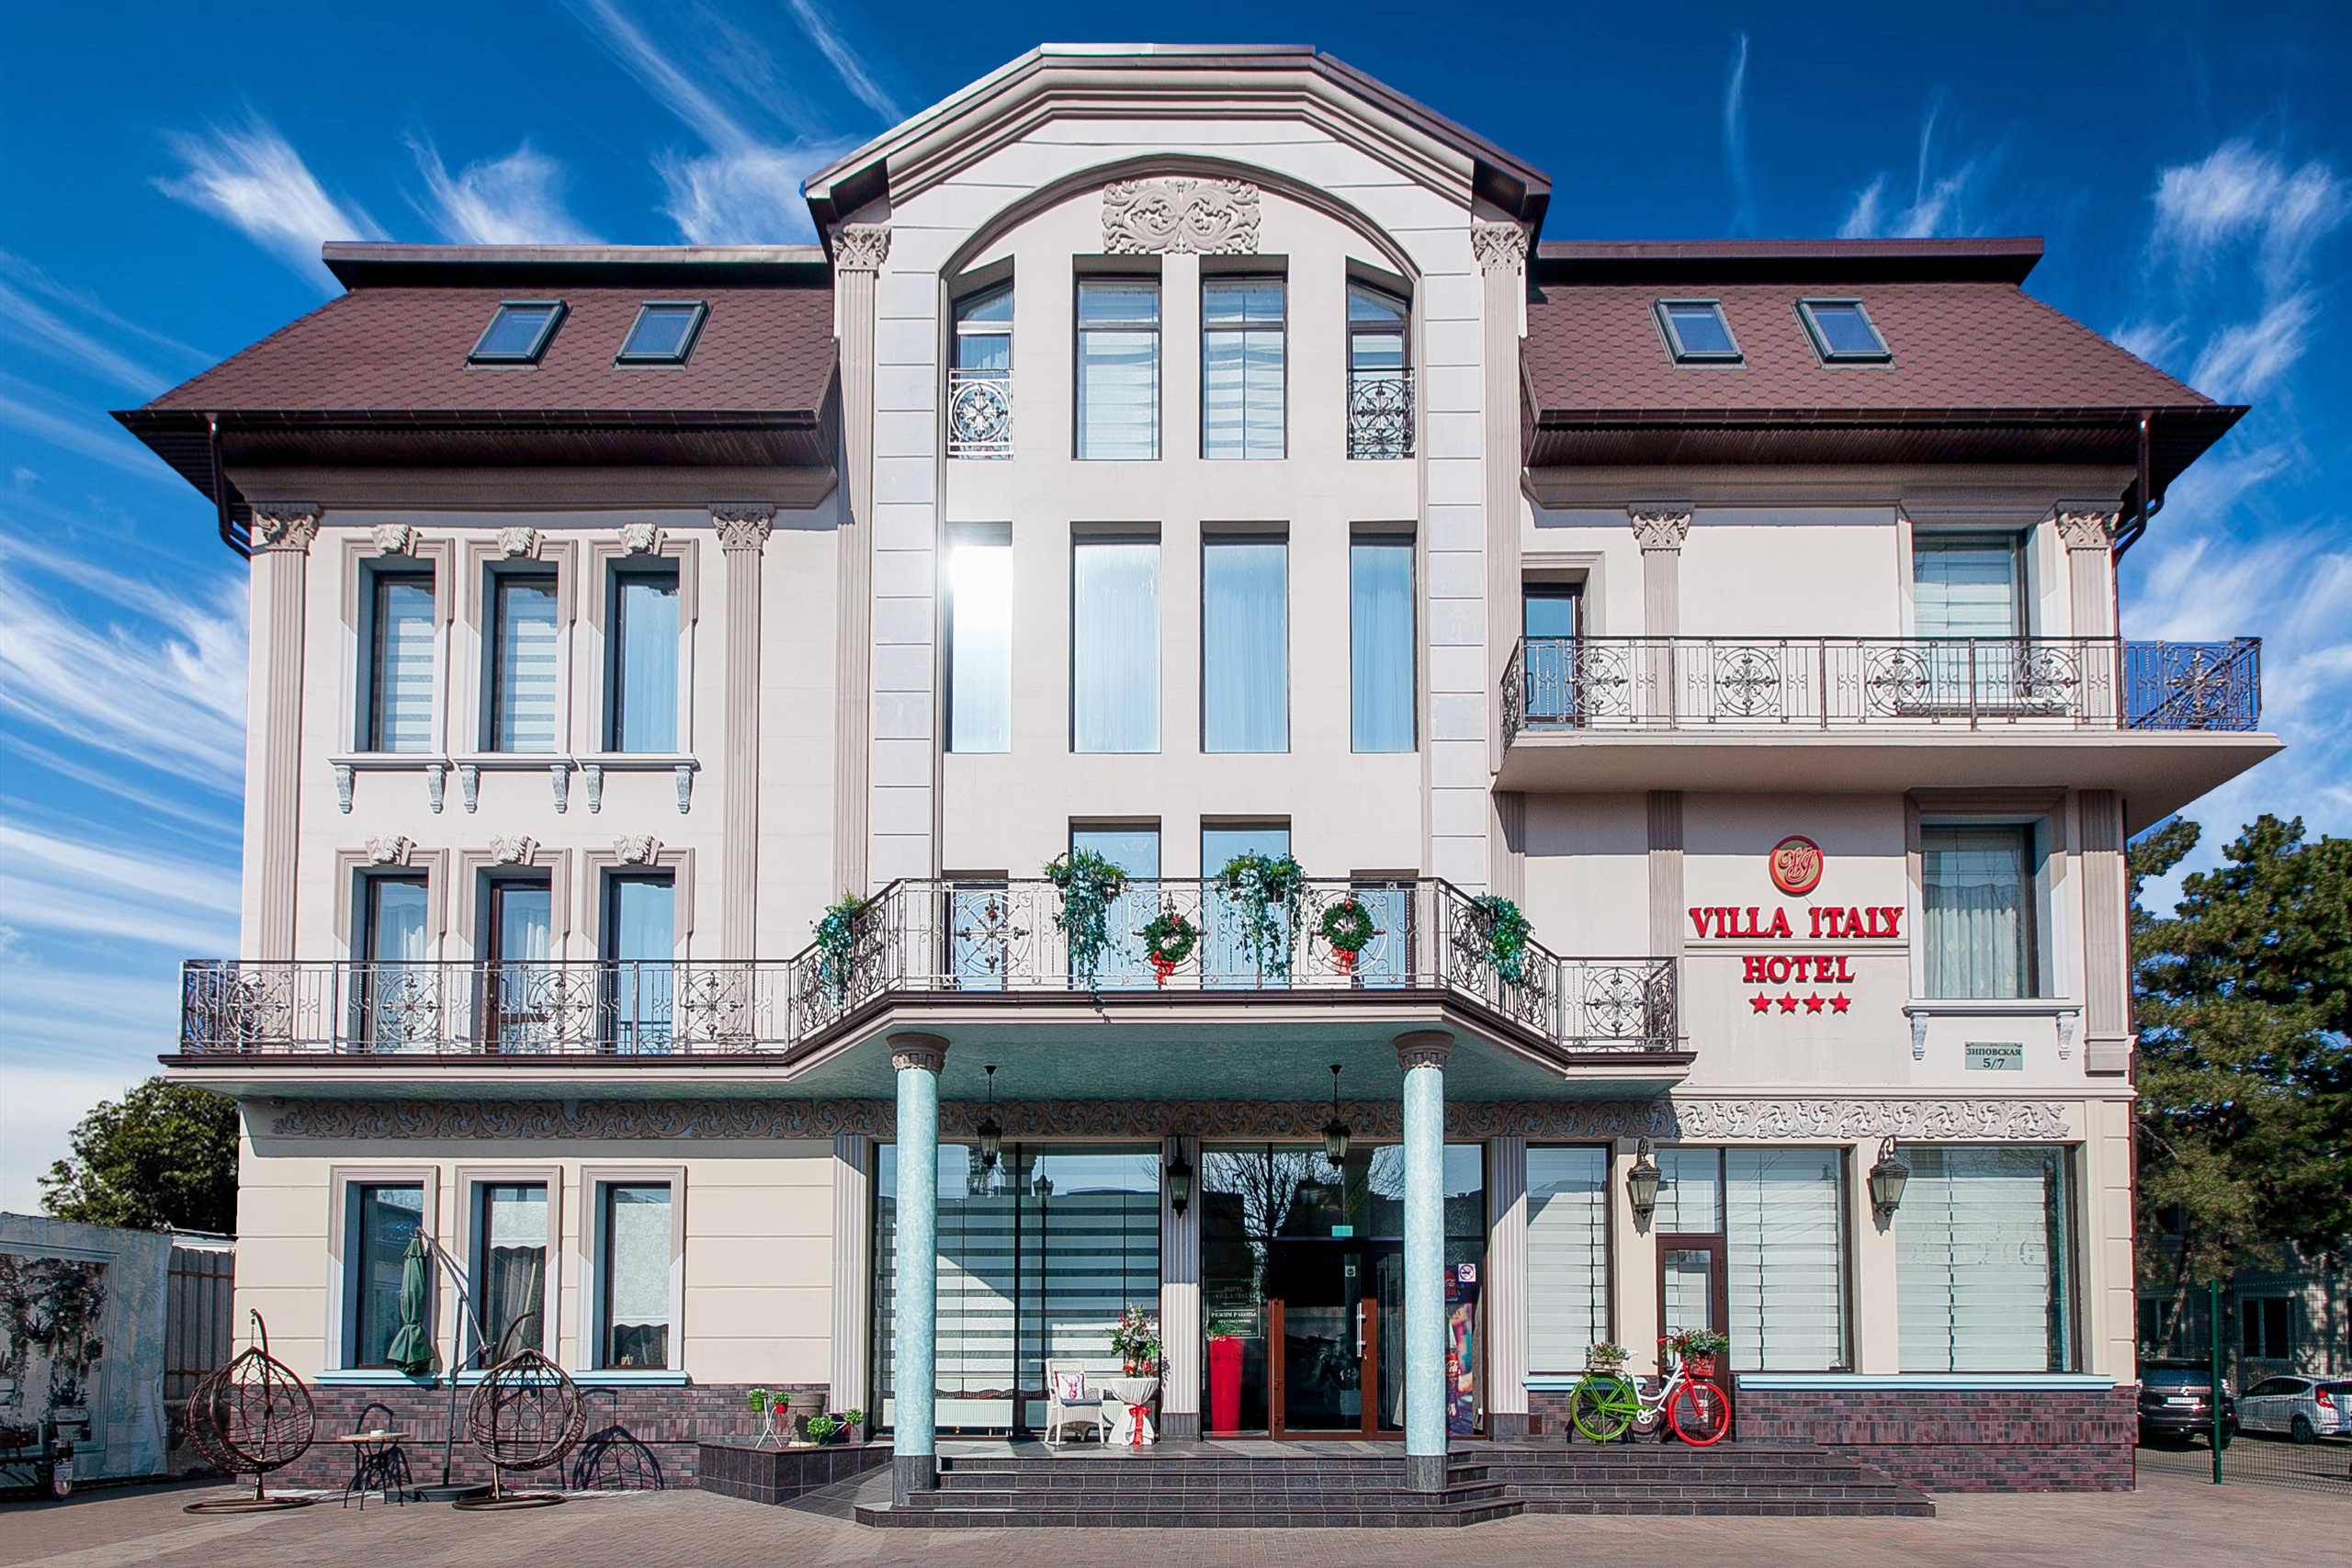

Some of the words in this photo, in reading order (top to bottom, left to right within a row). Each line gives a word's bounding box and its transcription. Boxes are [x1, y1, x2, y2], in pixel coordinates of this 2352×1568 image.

[1689, 907, 1792, 938] VILLA
[1808, 907, 1904, 938] ITALY
[1743, 955, 1856, 983] HOTEL
[1966, 1048, 2021, 1056] ЗИПОВСКАЯ
[1983, 1058, 2006, 1069] 5/7
